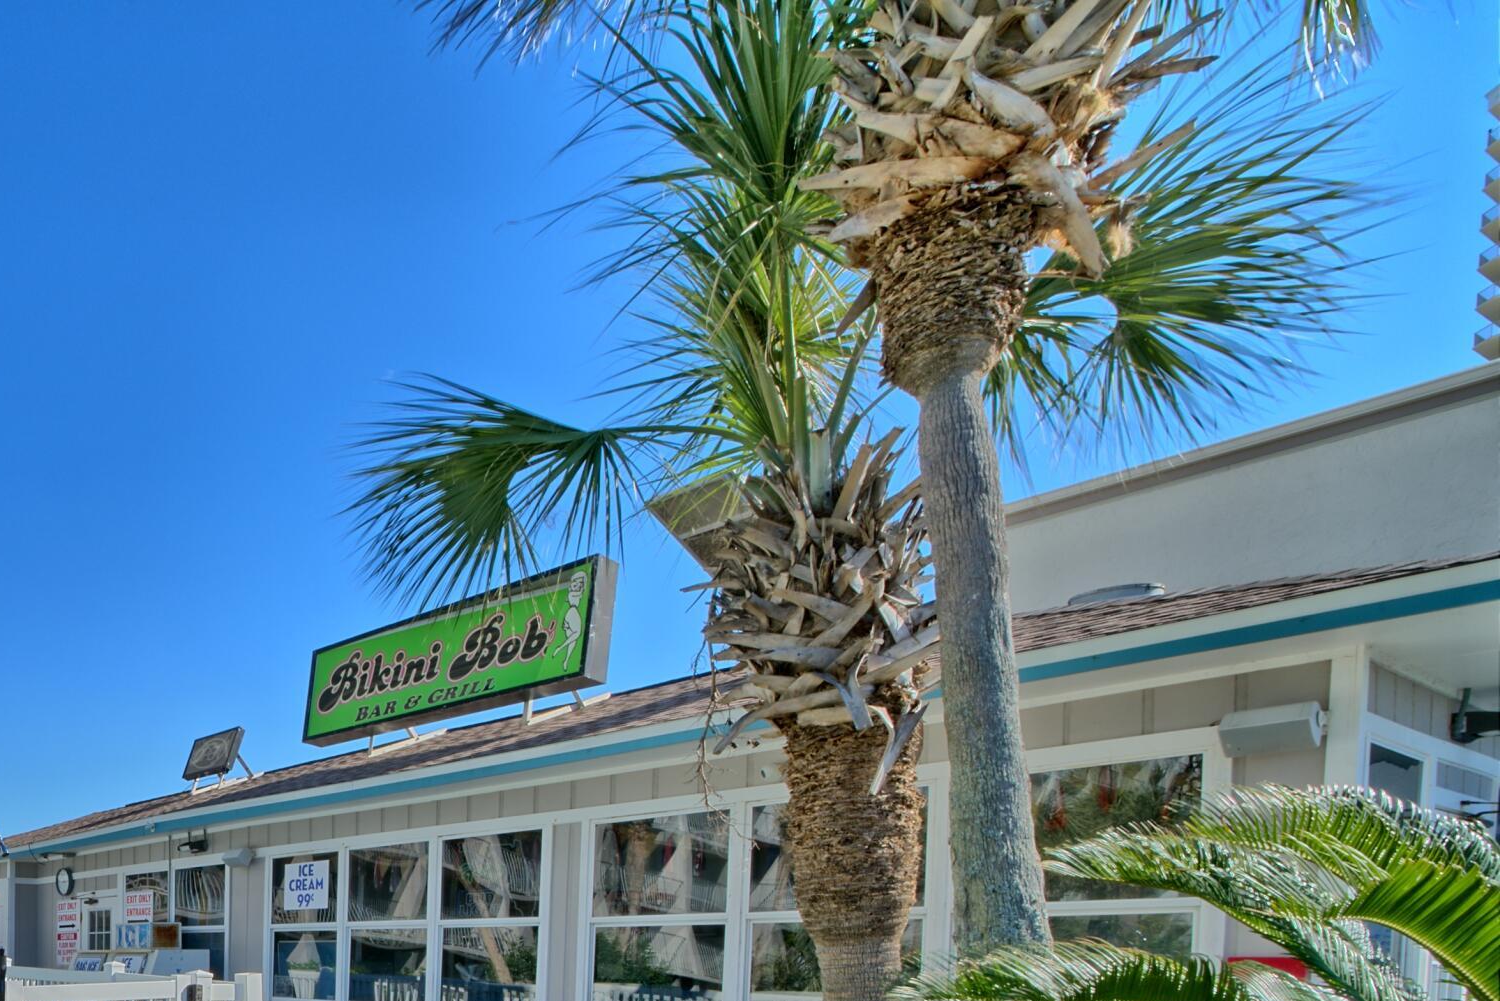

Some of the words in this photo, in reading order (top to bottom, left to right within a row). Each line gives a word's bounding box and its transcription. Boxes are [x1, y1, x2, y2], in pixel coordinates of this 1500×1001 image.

[317, 640, 443, 714] Bikini
[355, 699, 396, 722] BAR
[404, 696, 421, 710] &
[427, 677, 496, 706] GRILL
[298, 863, 315, 878] ICE
[288, 877, 324, 892] CREAM
[126, 895, 137, 904] EXIT
[138, 894, 151, 903] ONLY
[126, 906, 151, 917] ENTRANCE
[117, 924, 149, 949] ICE
